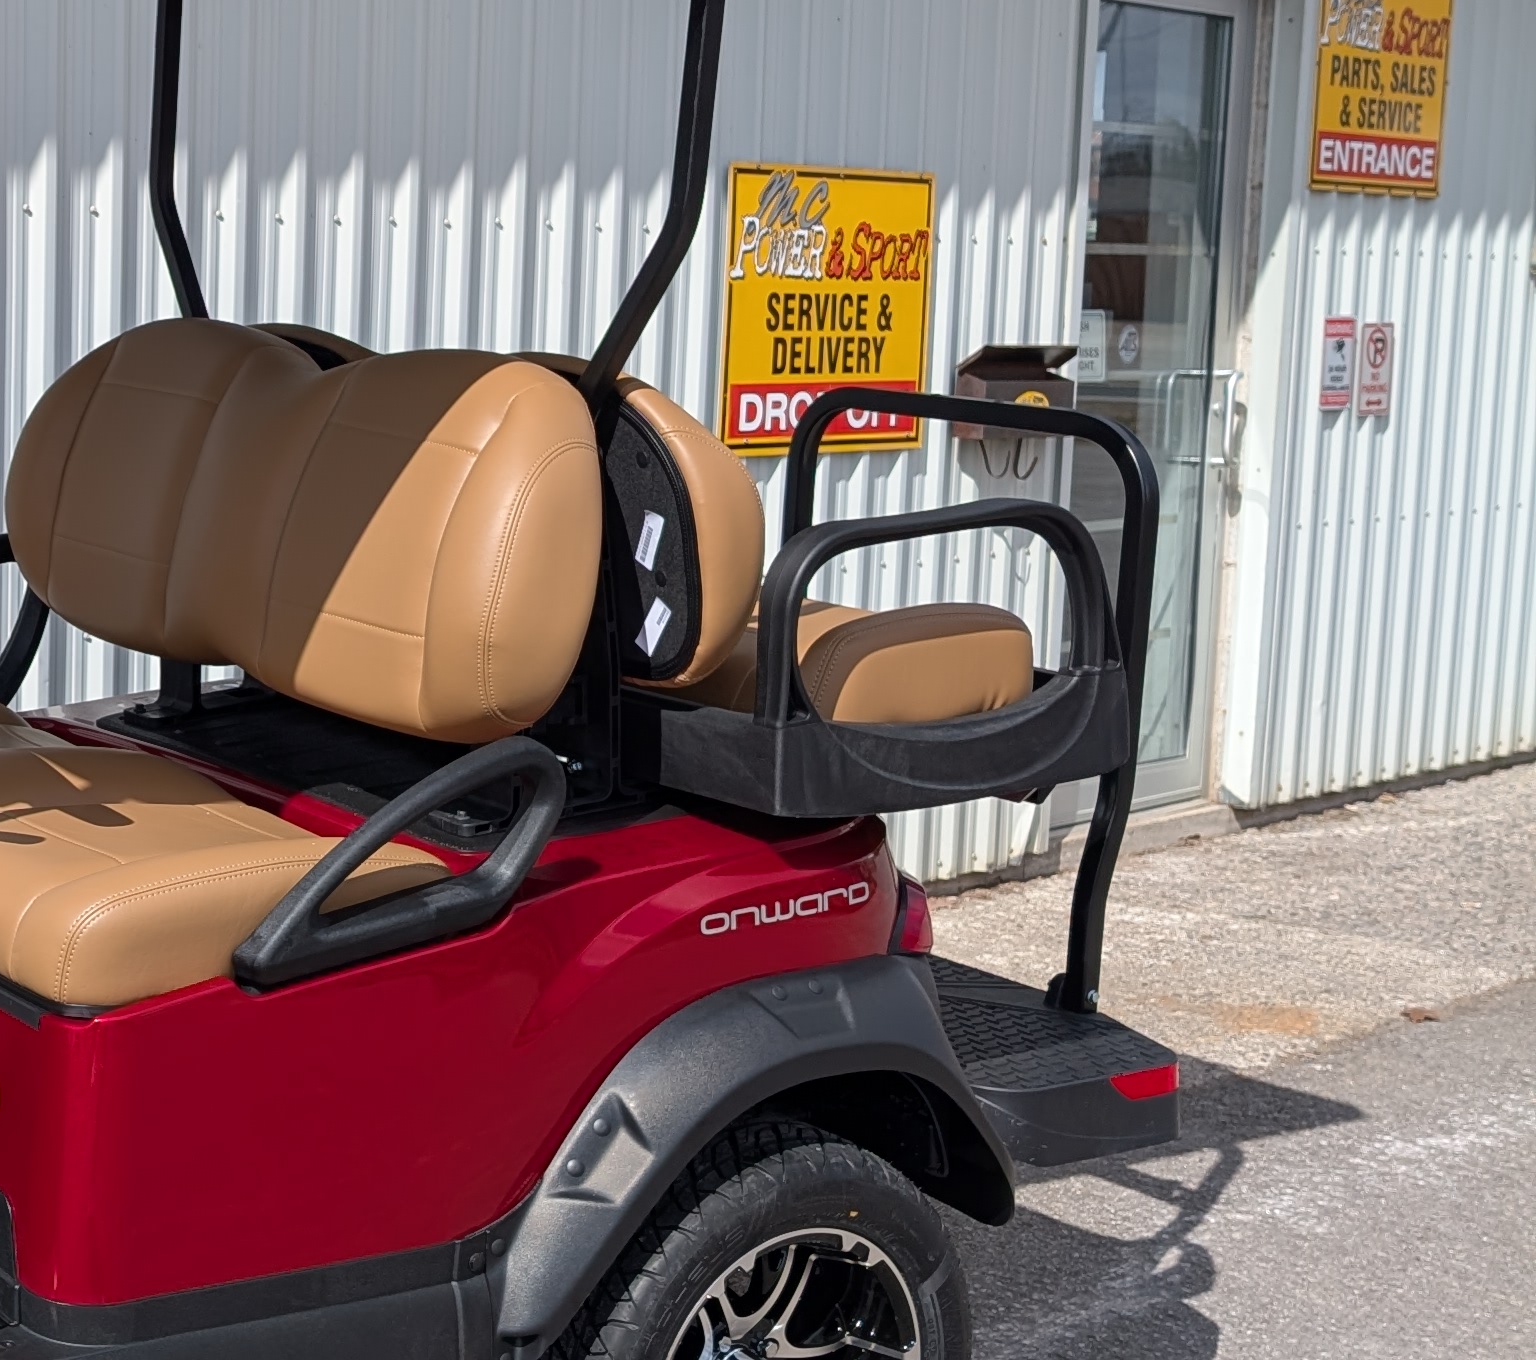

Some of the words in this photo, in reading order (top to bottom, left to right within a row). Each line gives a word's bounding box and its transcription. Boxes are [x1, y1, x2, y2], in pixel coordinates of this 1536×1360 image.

[1382, 10, 1395, 52] &
[1330, 54, 1385, 96] PARTS,
[1390, 62, 1436, 97] SALES
[1339, 94, 1351, 127] &
[1357, 96, 1423, 133] SERVICE
[1319, 138, 1435, 180] ENTRANCE
[729, 215, 827, 280] POWER
[825, 227, 845, 280] &
[846, 221, 929, 281] SPORT
[766, 292, 868, 332] SERVICE
[876, 293, 892, 332] &
[771, 336, 886, 375] DELIVERY
[738, 391, 825, 432] DRO
